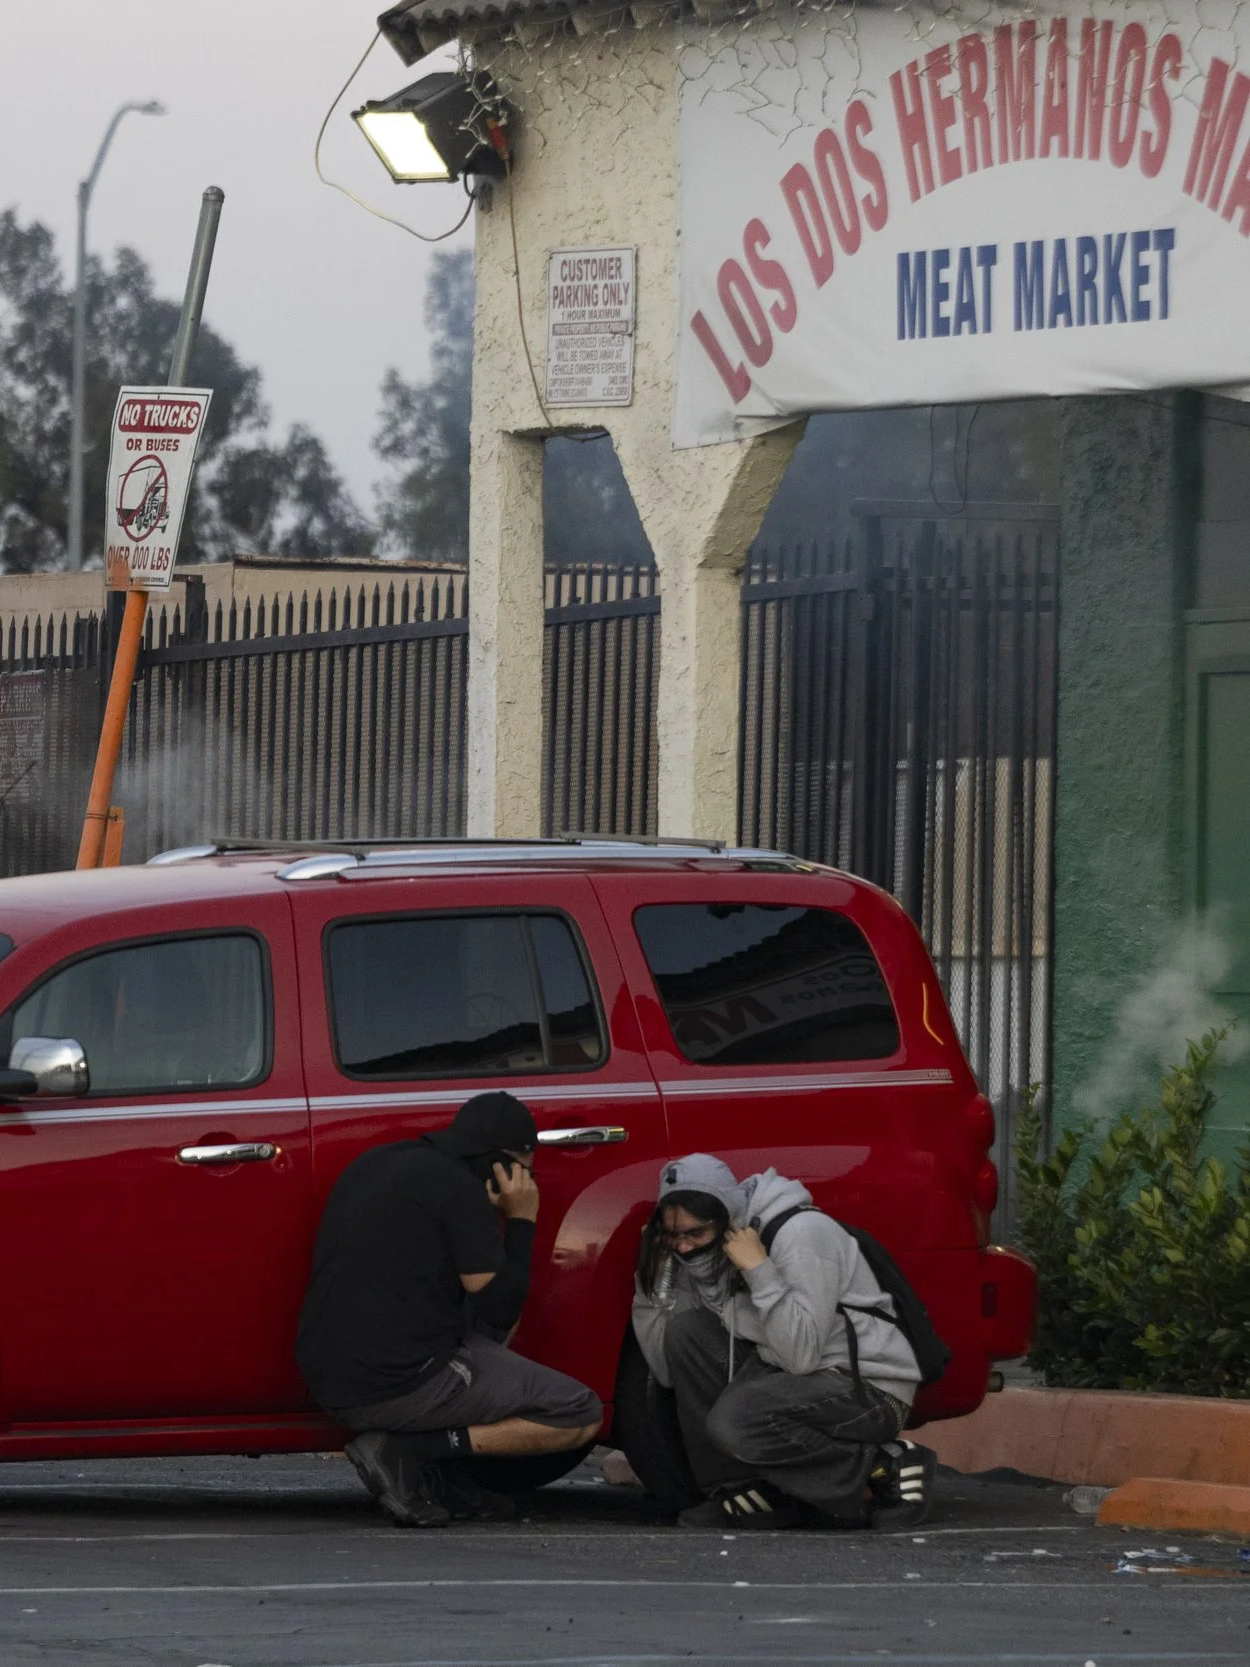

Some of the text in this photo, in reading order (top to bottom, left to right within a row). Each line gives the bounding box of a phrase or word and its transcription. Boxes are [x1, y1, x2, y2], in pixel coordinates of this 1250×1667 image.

[690, 217, 798, 405] LOS
[779, 99, 889, 291] DOS
[889, 17, 1183, 204] HERMANOS
[560, 257, 622, 283] CUSTOMER
[552, 282, 630, 309] PARKING ONLY
[896, 227, 1176, 341] MEAT MARKET
[567, 310, 586, 321] HOUR
[588, 308, 621, 320] MAXIMUM
[120, 403, 200, 429] NO TRUCKS
[126, 438, 180, 452] OR BUSES
[150, 547, 171, 571] LBS
